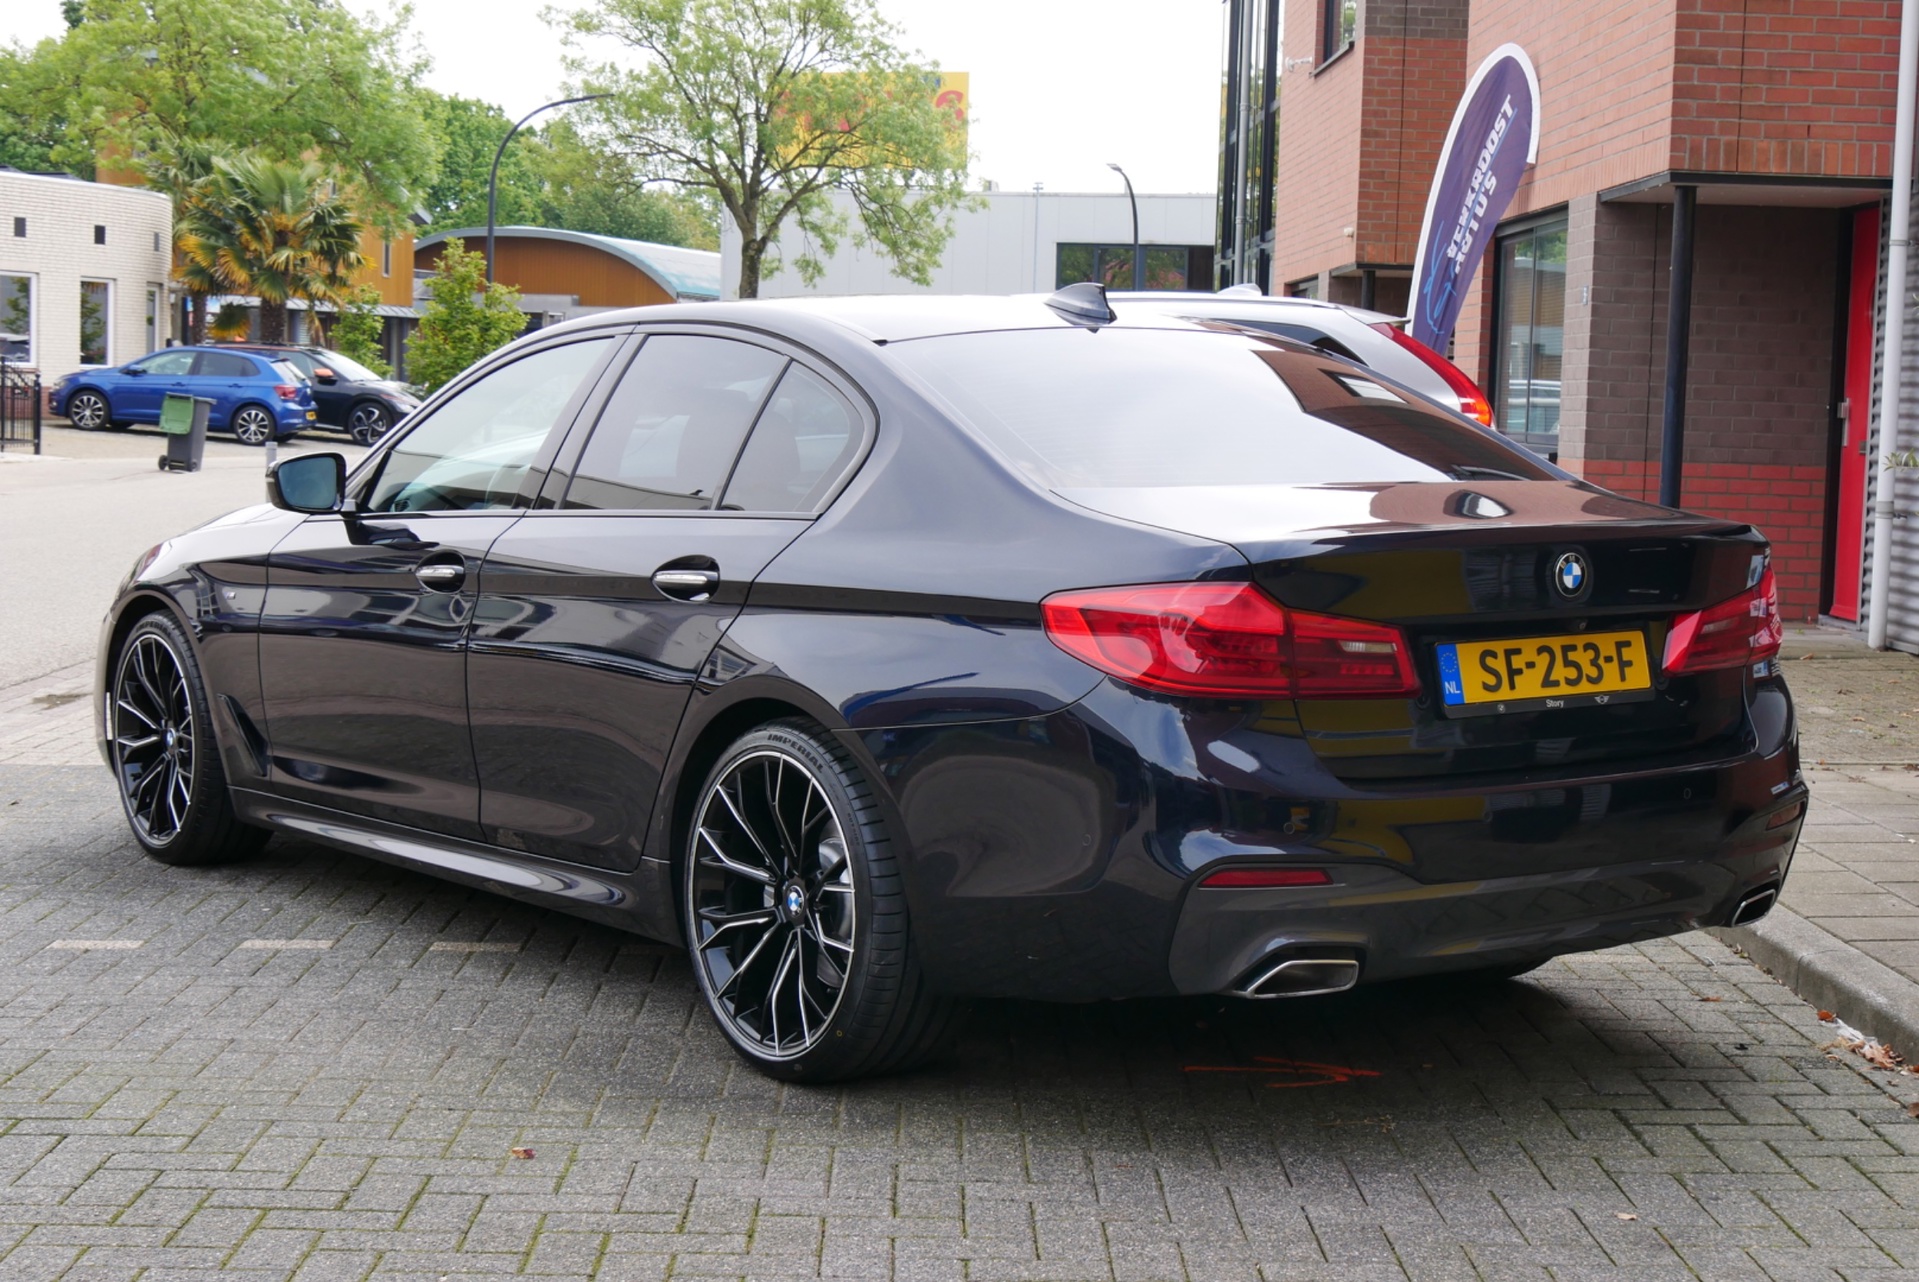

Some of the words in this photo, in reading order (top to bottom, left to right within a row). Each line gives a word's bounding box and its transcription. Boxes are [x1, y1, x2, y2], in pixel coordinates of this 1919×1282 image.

[1444, 681, 1461, 695] NL
[1478, 640, 1634, 693] SF-253-F
[1545, 698, 1565, 709] Story
[766, 733, 824, 774] IMPERIAL
